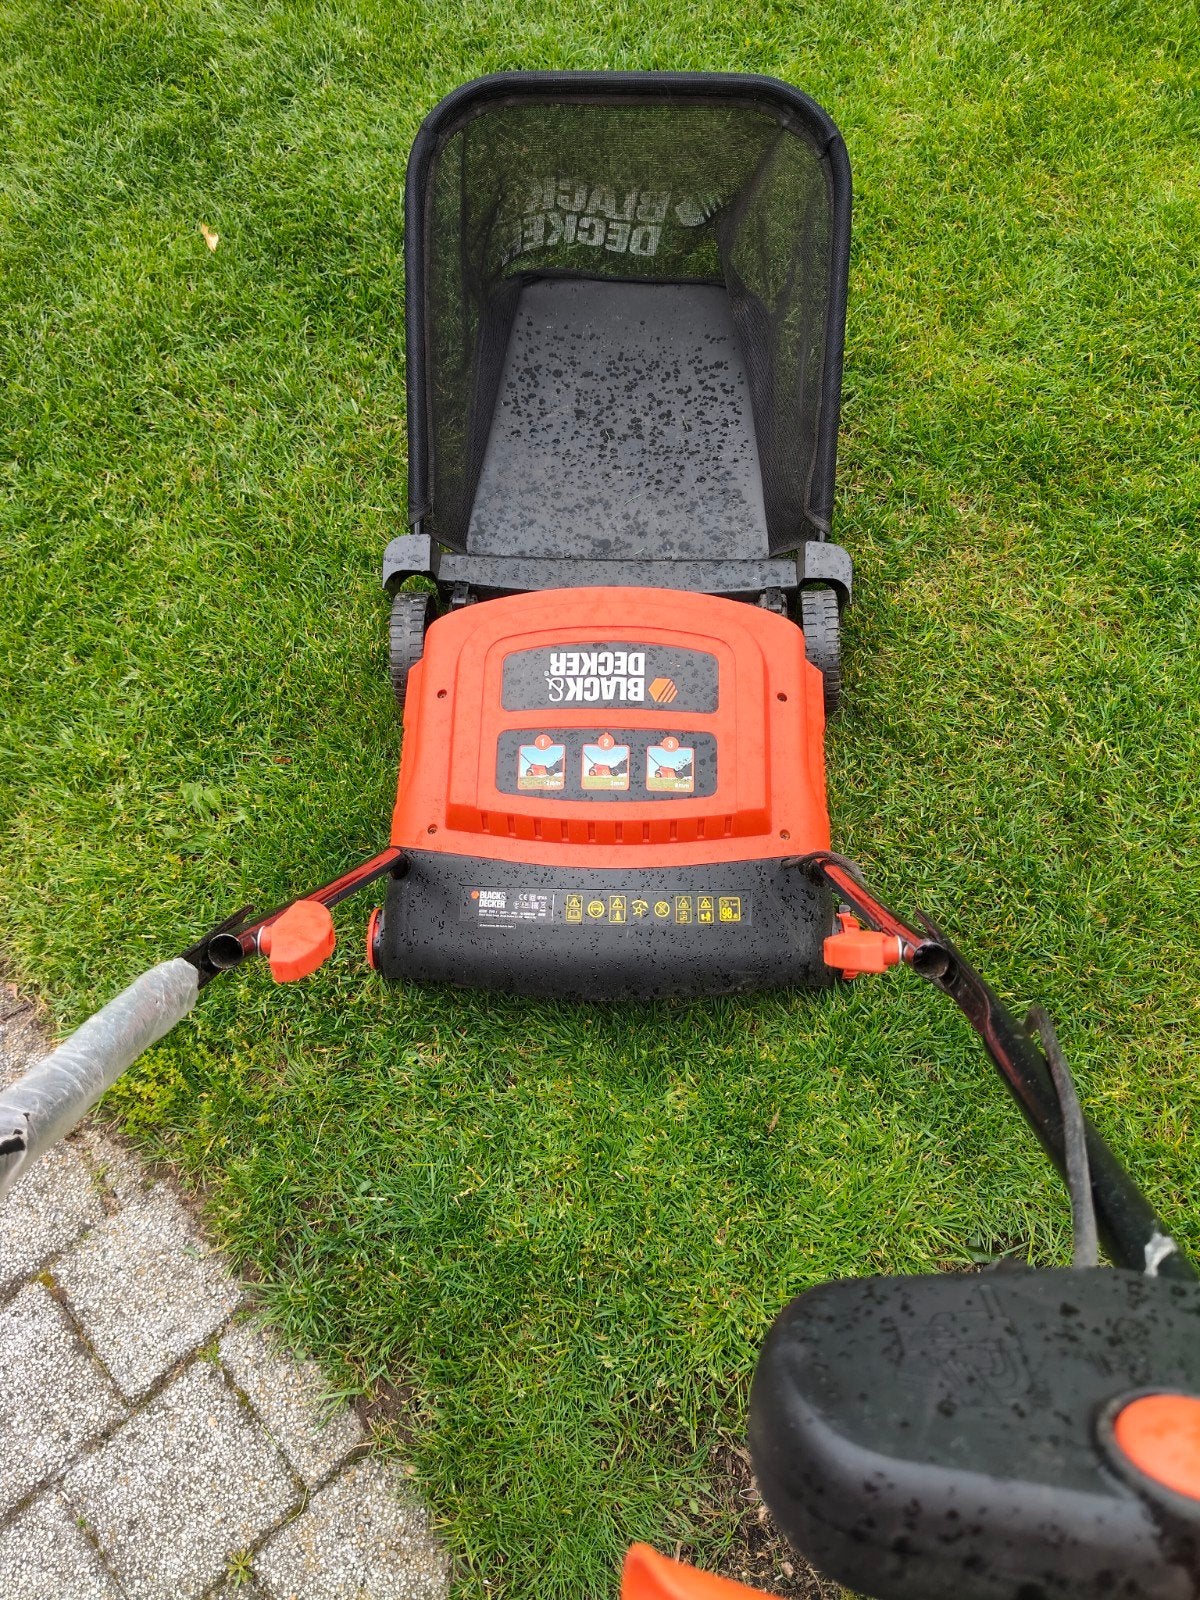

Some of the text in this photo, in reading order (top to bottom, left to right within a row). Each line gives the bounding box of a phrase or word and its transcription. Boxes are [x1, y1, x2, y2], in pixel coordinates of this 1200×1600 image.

[550, 651, 646, 676] DECKER
[546, 677, 645, 702] BLACK&
[540, 738, 545, 746] 1
[603, 739, 609, 747] 2
[667, 740, 673, 748] 3
[479, 900, 506, 909] DECKER
[722, 907, 732, 918] 98
